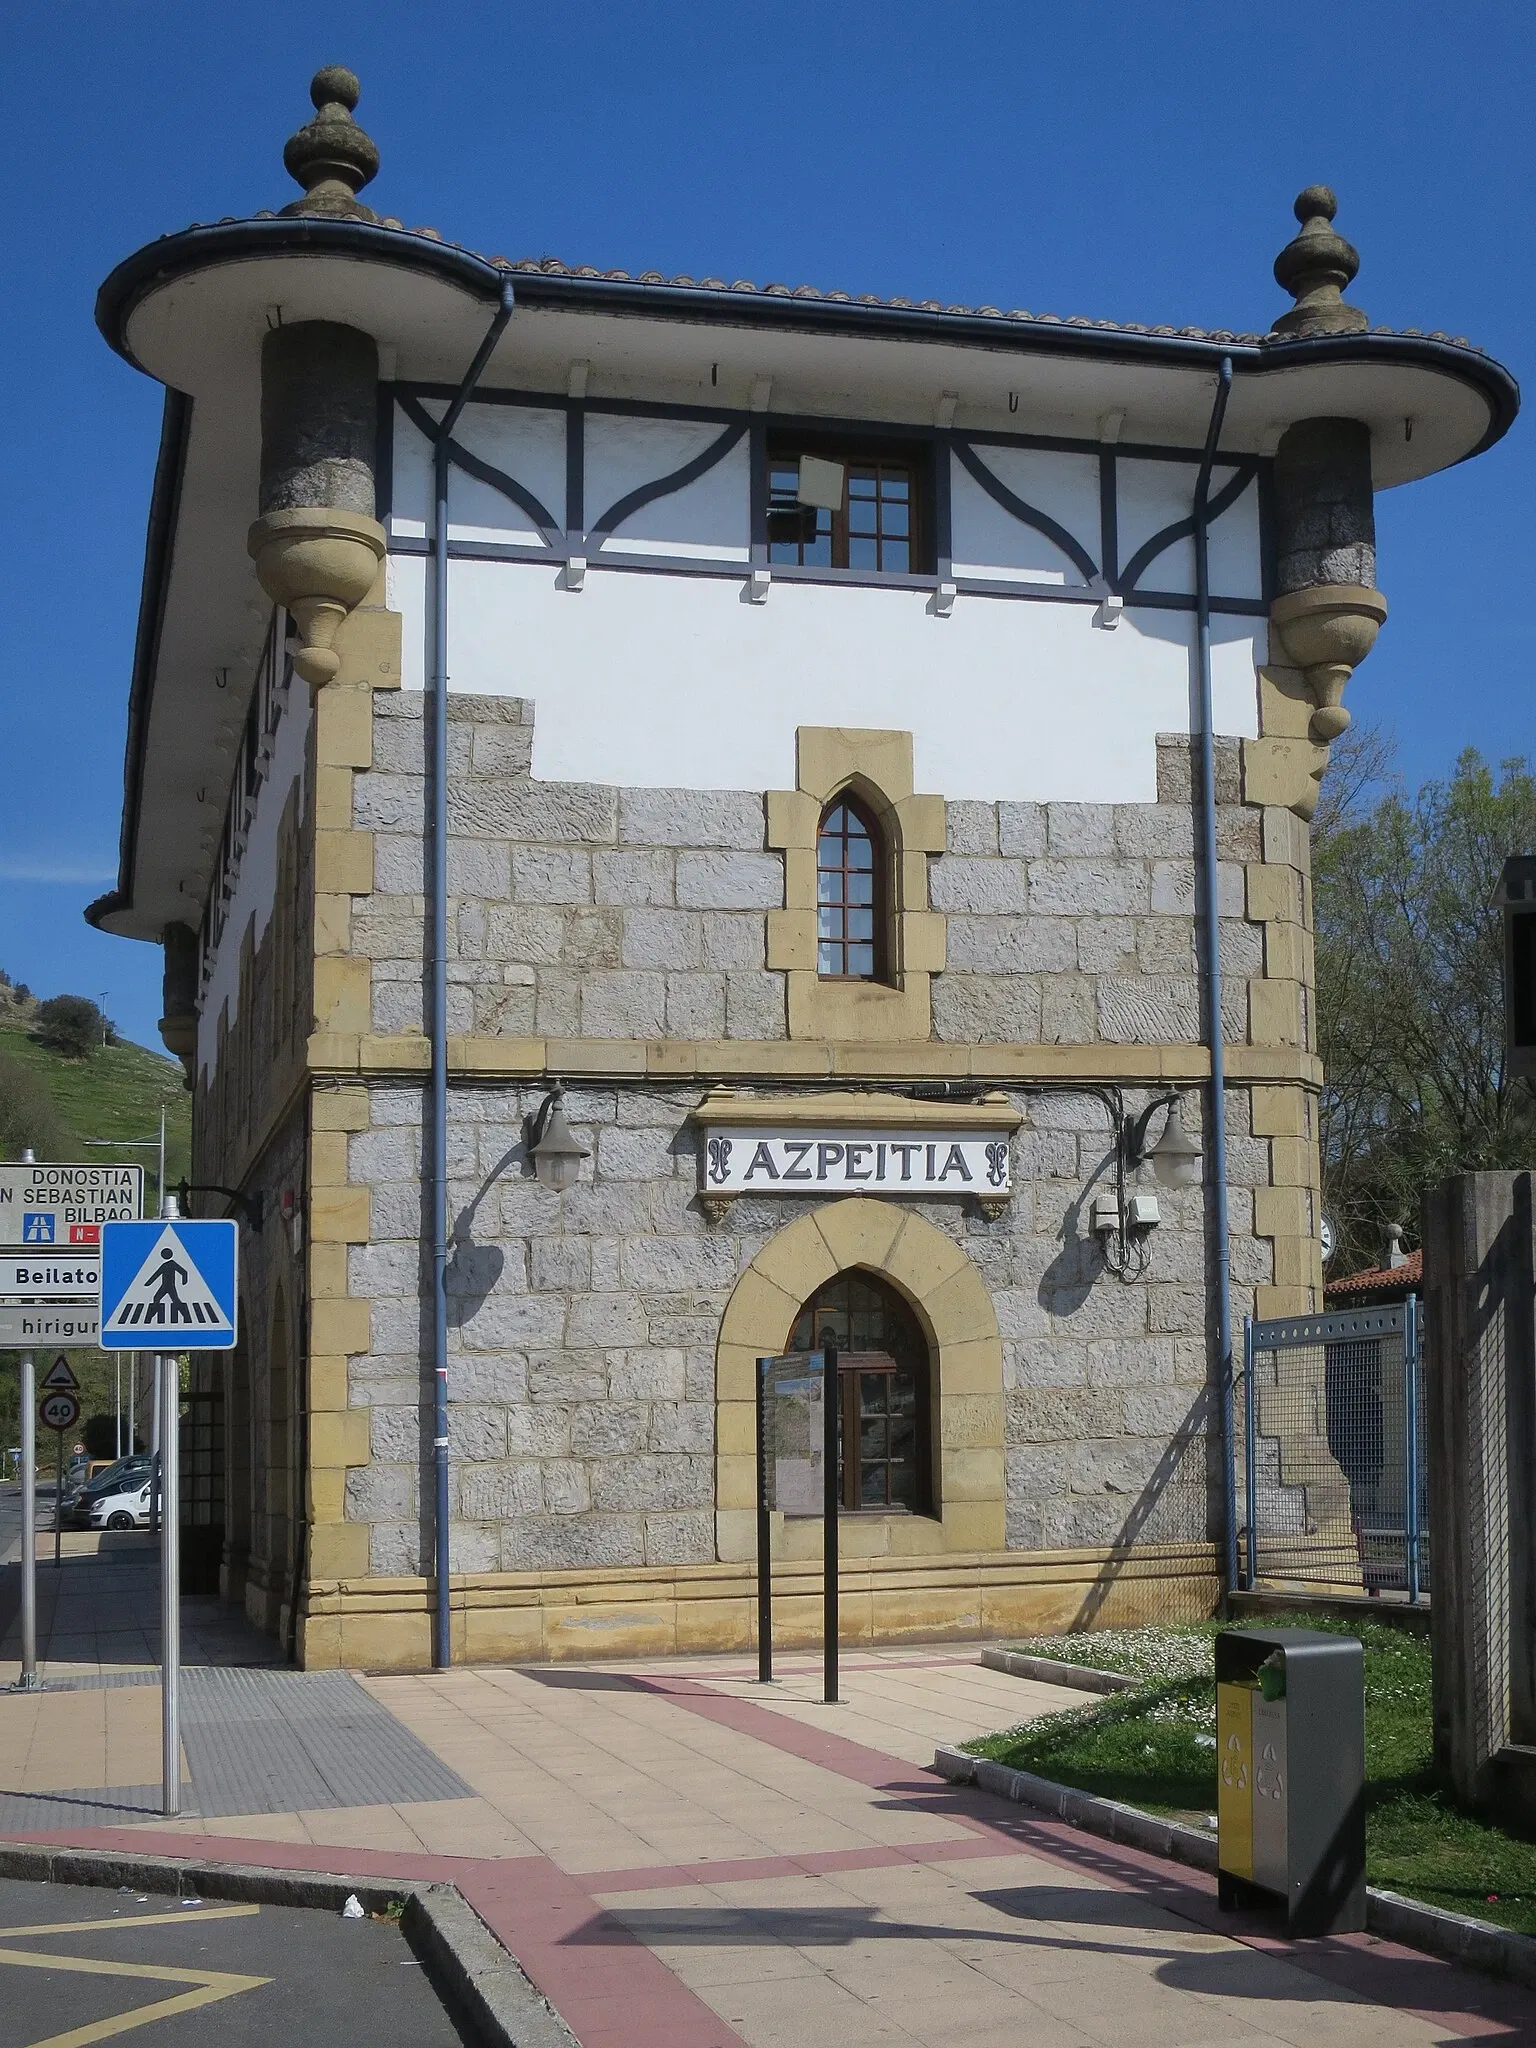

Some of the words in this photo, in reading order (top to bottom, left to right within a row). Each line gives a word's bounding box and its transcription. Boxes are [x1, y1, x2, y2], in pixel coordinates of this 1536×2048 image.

[743, 1142, 974, 1182] AZPEITIA
[32, 1170, 133, 1185] DONOSTIA
[23, 1189, 132, 1204] SEBASTIAN
[65, 1208, 132, 1222] BILBAO
[48, 1404, 71, 1417] 40
